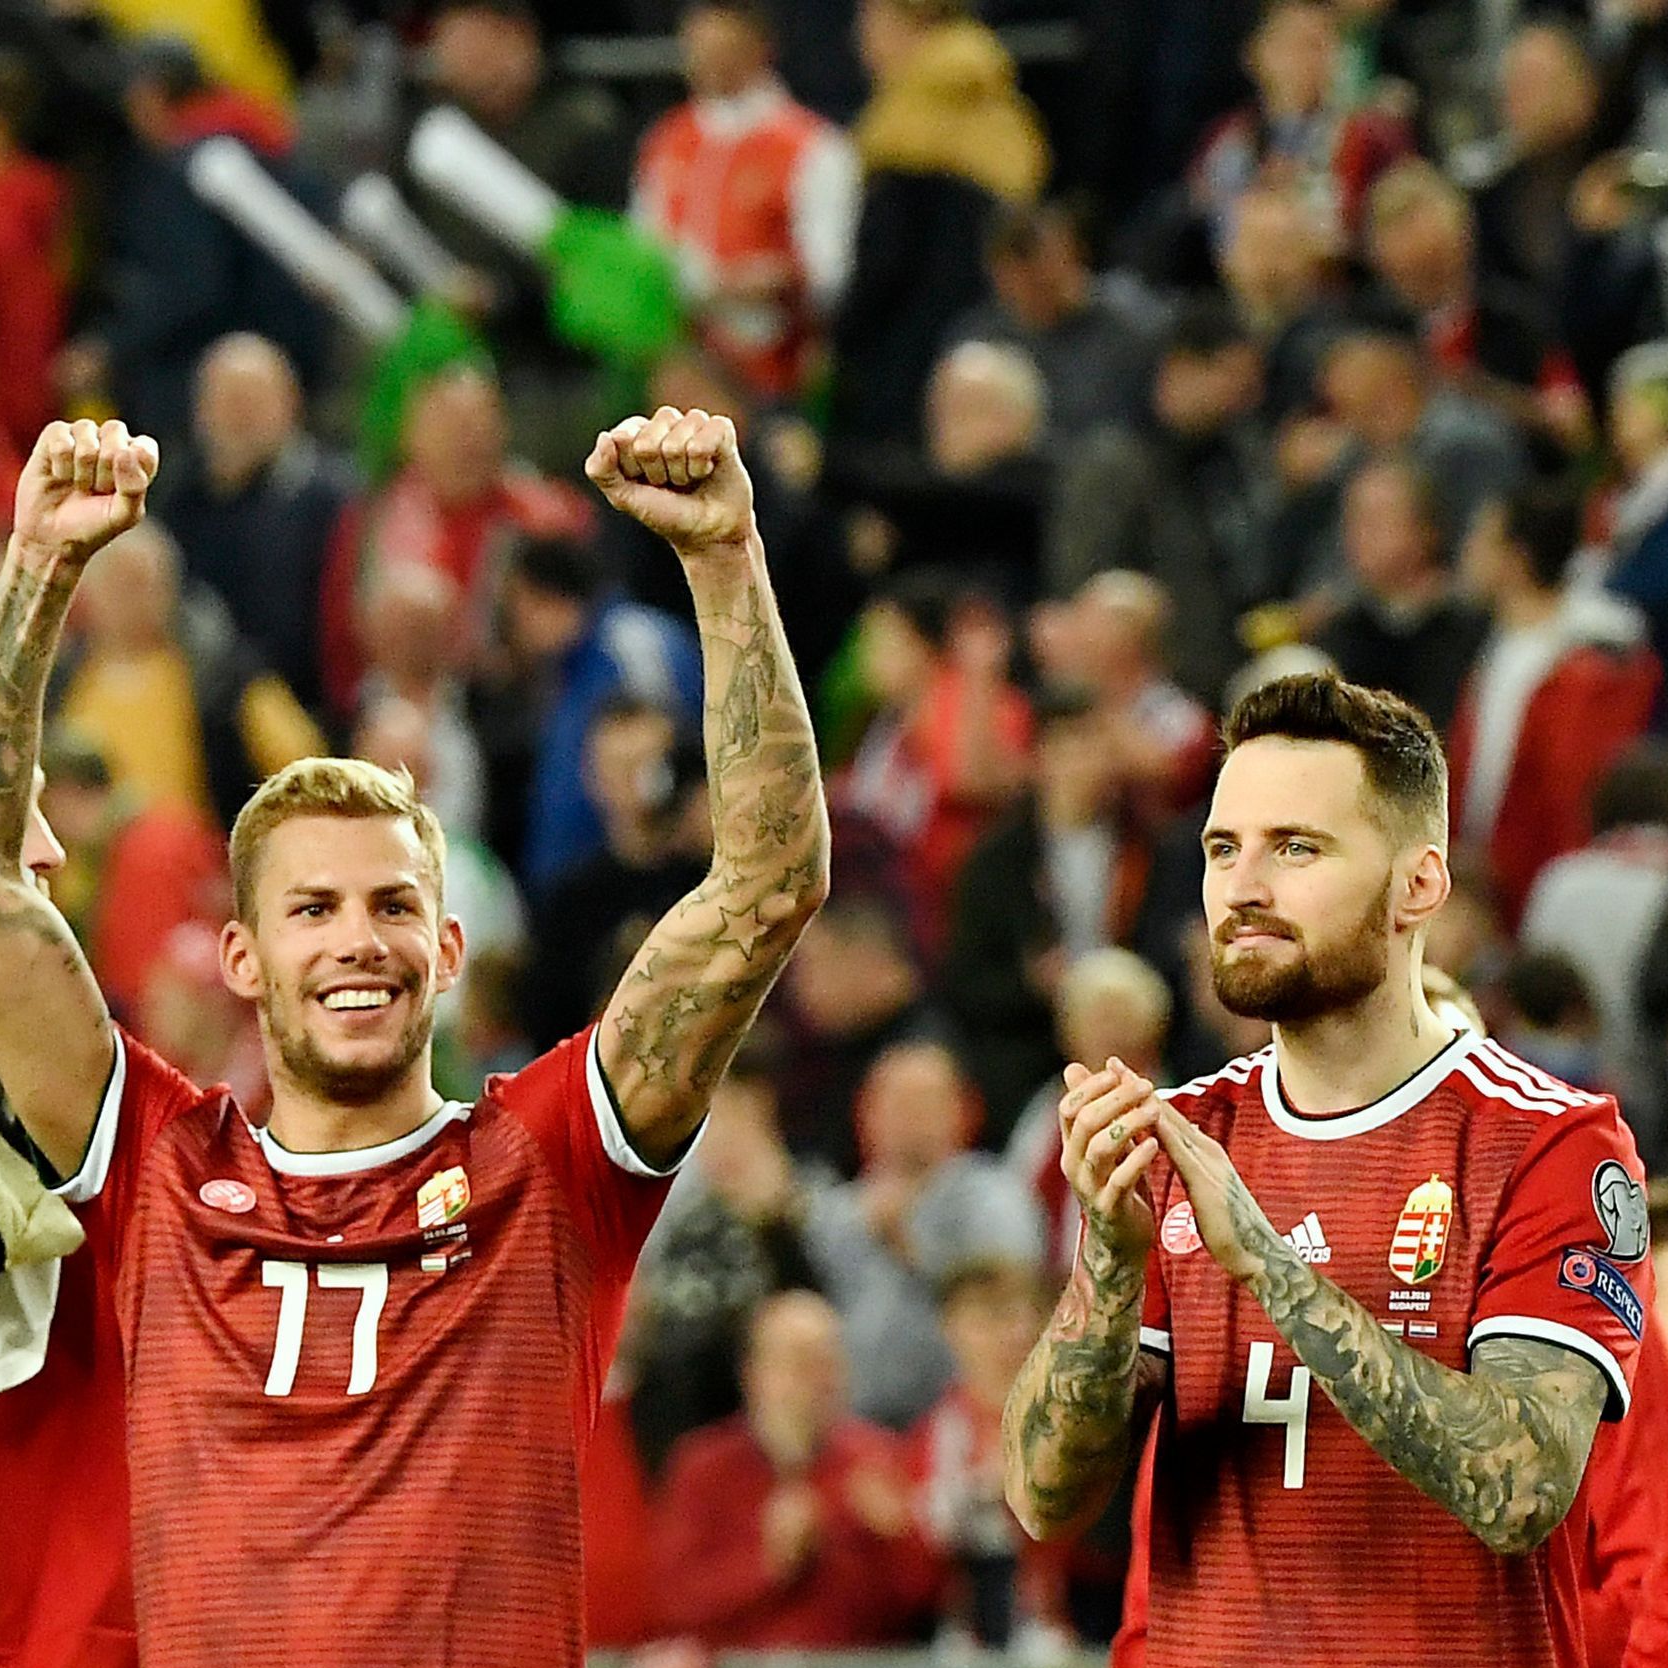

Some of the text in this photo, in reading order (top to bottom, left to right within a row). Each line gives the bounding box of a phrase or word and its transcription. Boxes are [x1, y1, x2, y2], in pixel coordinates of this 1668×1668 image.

[262, 1260, 389, 1396] 17
[1596, 1271, 1643, 1331] RESPECT
[1242, 1341, 1311, 1489] 4
